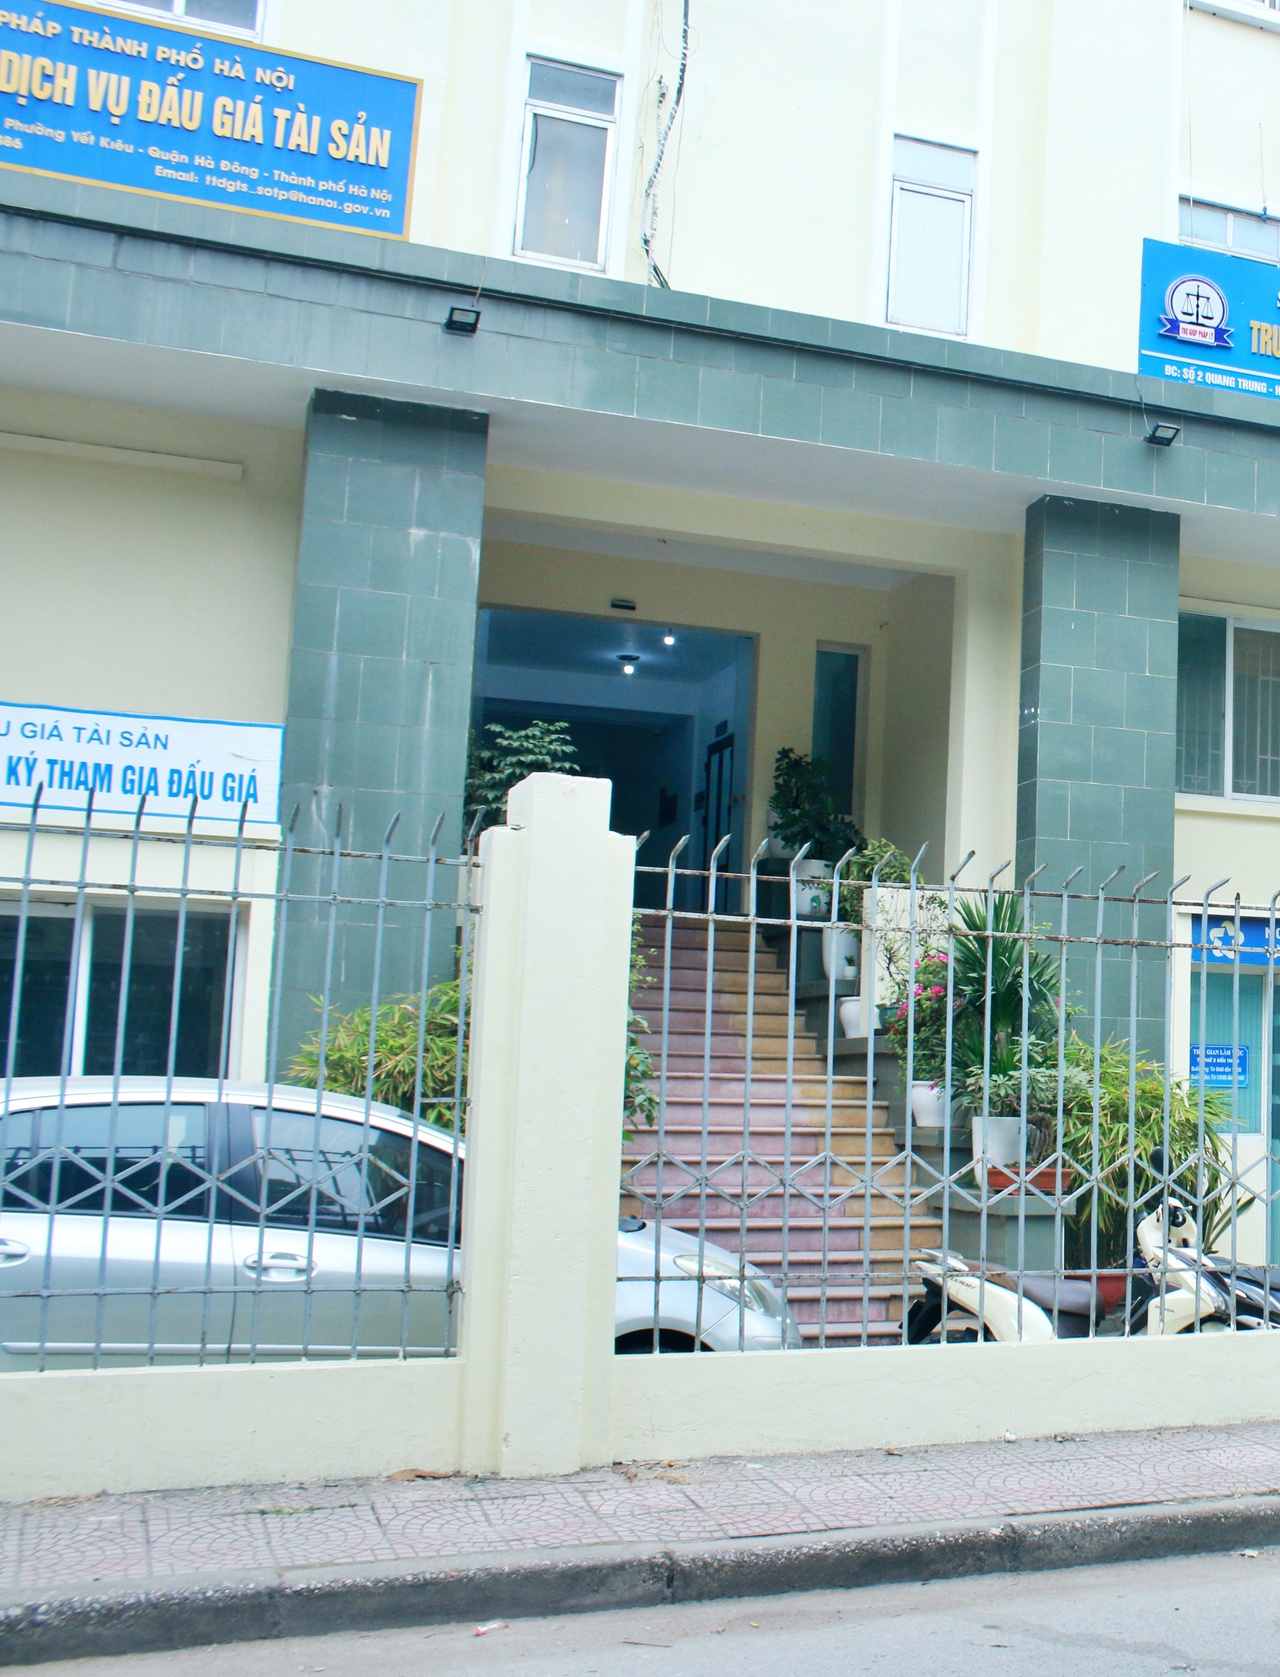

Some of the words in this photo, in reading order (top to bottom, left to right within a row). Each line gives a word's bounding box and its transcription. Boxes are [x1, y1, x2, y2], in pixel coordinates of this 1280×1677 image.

[0, 10, 62, 38] PHÁP
[70, 25, 148, 59] THÀNH
[156, 42, 204, 70] PHỐ
[213, 55, 246, 81] HÀ
[255, 66, 295, 92] NỘI
[0, 49, 78, 106] DỊCH
[87, 68, 130, 125] VỤ
[137, 72, 203, 131] ĐẤU
[212, 94, 264, 144] GIÁ
[273, 102, 321, 155] TÀI
[328, 111, 391, 169] SẢN
[0, 134, 23, 149] 86
[4, 117, 66, 143] Phường
[71, 130, 95, 146] Yết
[147, 146, 188, 165] Quận
[194, 155, 215, 169] Hà
[220, 160, 259, 179] Đông
[273, 169, 315, 188] Thành
[318, 179, 347, 193] phố
[348, 184, 367, 198] Hà
[370, 188, 392, 204] Nội
[154, 165, 199, 183] Email:
[1164, 364, 1181, 377] ĐC:
[1182, 366, 1196, 380] SỐ
[1197, 371, 1203, 382] 2
[1205, 372, 1236, 388] QUANG
[1238, 378, 1267, 394] TRUNG
[21, 720, 63, 742] GIÁ
[73, 722, 110, 746] TÀI
[119, 726, 169, 750] SẢN
[6, 751, 38, 788] KÝ
[46, 758, 113, 793] THAM
[121, 765, 159, 796] GIA
[168, 760, 214, 800] ĐẤU
[222, 768, 258, 804] GIÁ
